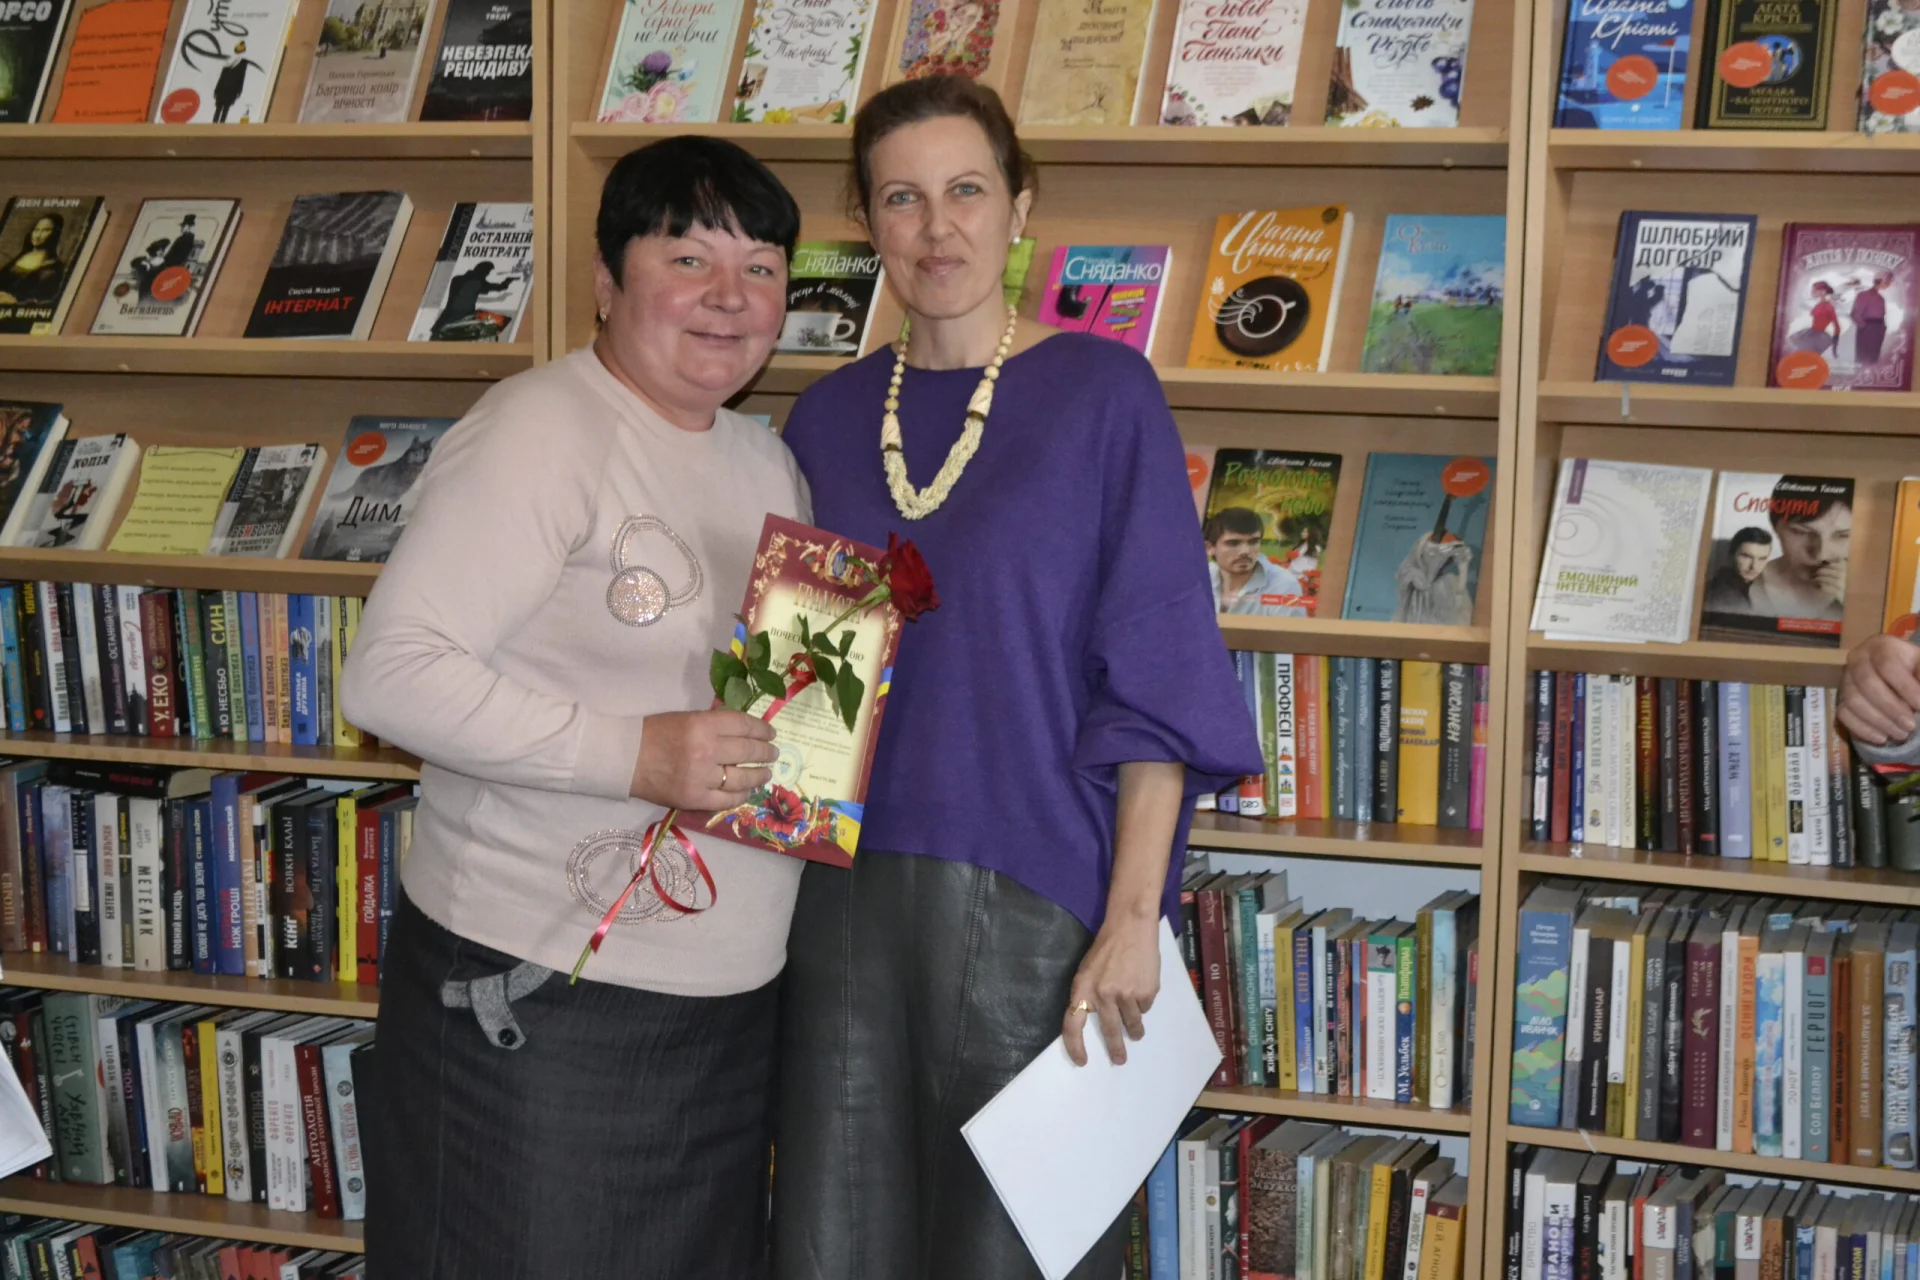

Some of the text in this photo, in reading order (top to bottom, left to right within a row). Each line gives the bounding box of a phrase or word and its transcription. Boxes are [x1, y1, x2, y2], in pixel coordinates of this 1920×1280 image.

[444, 61, 528, 80] РЕЦИДИВУ
[463, 245, 529, 258] КОНТРАКТ
[469, 228, 533, 243] ОСТАННІЙ
[1640, 225, 1744, 248] ШЛЮБНИЙ
[1065, 255, 1161, 283] Сняданко
[1636, 248, 1722, 268] ДОГОВІР
[264, 296, 355, 316] ІНТЕРНАТ
[72, 455, 111, 469] КОПІЯ
[337, 496, 402, 529] Дим
[1734, 492, 1821, 525] Спокута
[1556, 582, 1620, 595] ІНТЕЛЕКТ
[1558, 571, 1637, 587] ЕМОЦІЙНИЙ
[209, 604, 226, 645] СИН
[152, 674, 169, 704] ЕКО
[217, 667, 229, 712] НЕСБЬО
[1278, 663, 1292, 738] ПРОФЕСІЇ
[284, 853, 294, 892] ВОВКИ
[138, 866, 154, 935] МЕТЕЛИК
[173, 890, 183, 920] МІСЯЦЬ
[363, 875, 375, 924] ГОЙДАЛКА
[229, 888, 242, 948] НІЖ ГРОШІ
[172, 921, 183, 955] ПОВНИЙ
[1297, 937, 1308, 968] ТІНІ
[1298, 970, 1309, 1003] СИН
[1213, 990, 1225, 1028] ДАШВАР
[1398, 946, 1413, 1095] М. Уельбек Платформа
[1593, 987, 1605, 1042] КРИНИЧАР
[1265, 1007, 1275, 1073] ЖІНКА ЗІ СНІГУ
[1807, 990, 1825, 1135] Сол Беллоу ГЕРЦОГ
[310, 1066, 319, 1094] ПРОЗИ
[304, 1094, 321, 1167] АНТОЛОГІЯ
[319, 1142, 332, 1194] УКРАЇНСЬКОЇ
[1526, 1221, 1536, 1269] БРАТСТВО
